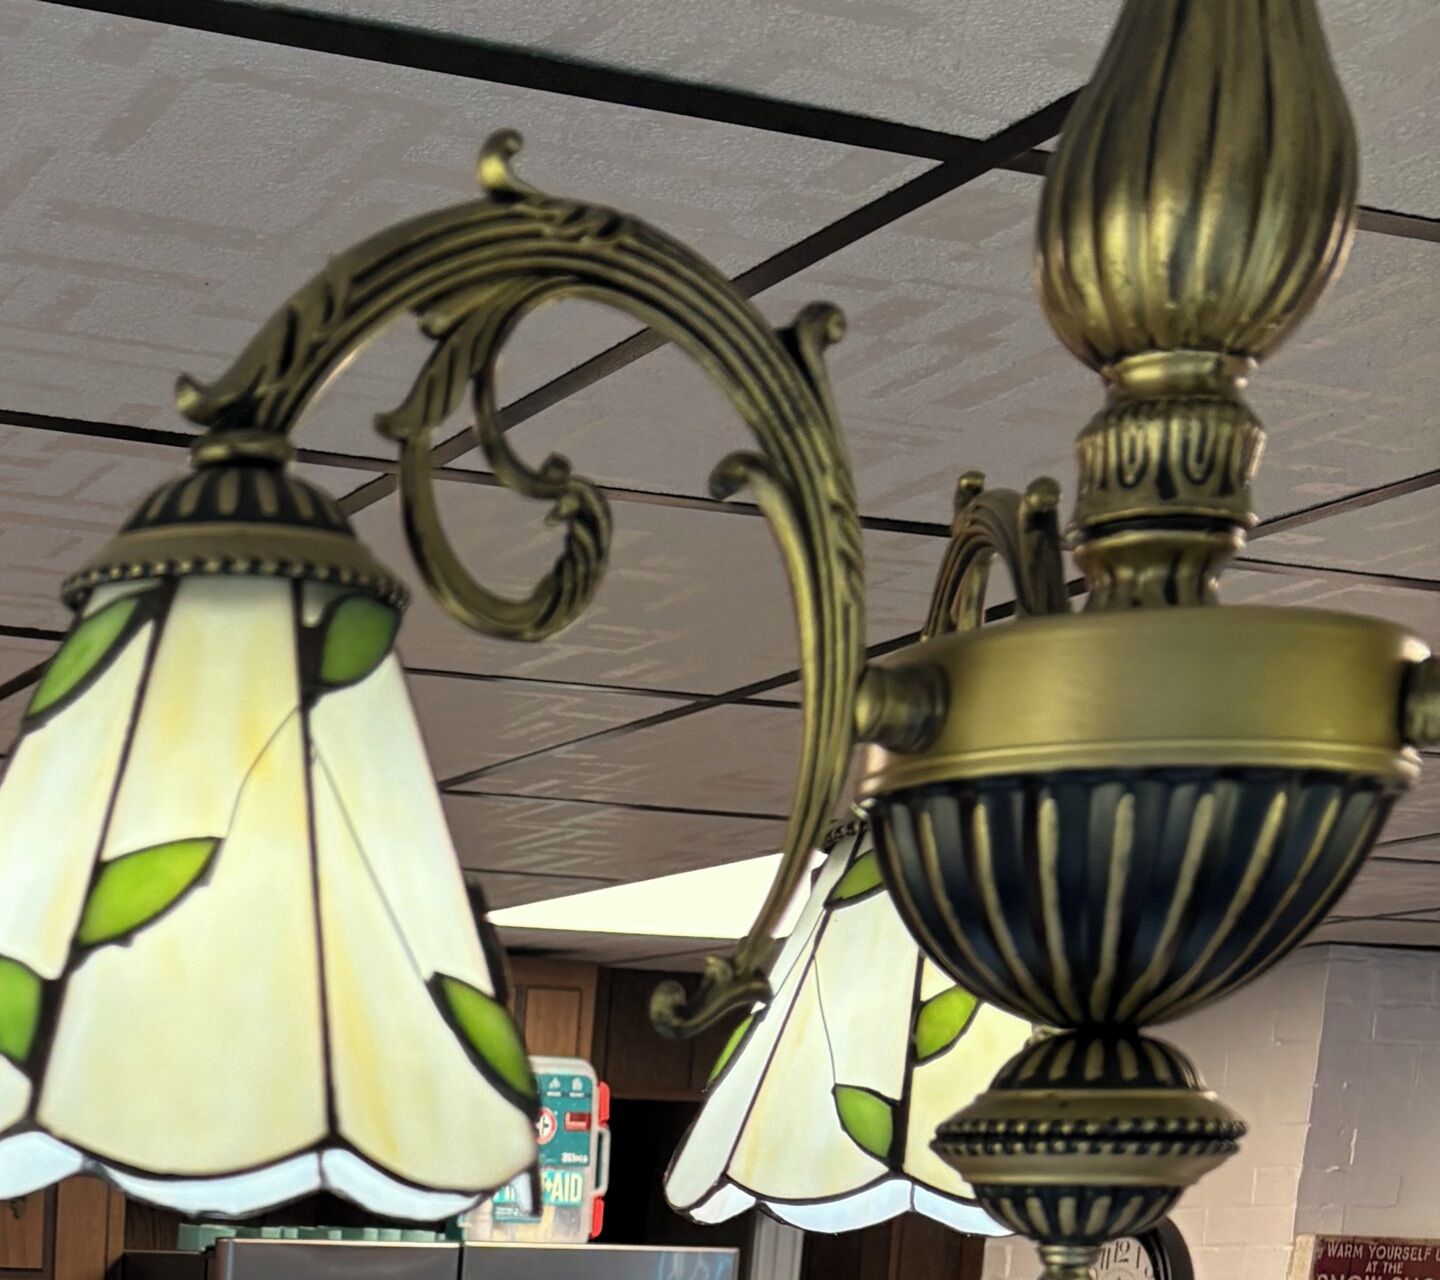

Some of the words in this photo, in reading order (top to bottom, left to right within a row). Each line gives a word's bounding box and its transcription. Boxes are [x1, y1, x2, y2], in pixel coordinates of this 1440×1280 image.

[1114, 1240, 1131, 1264] 12
[1327, 1241, 1364, 1259] WARM
[1368, 1244, 1432, 1261] YOURSELF
[1365, 1260, 1379, 1273] AT
[1383, 1261, 1404, 1274] THE
